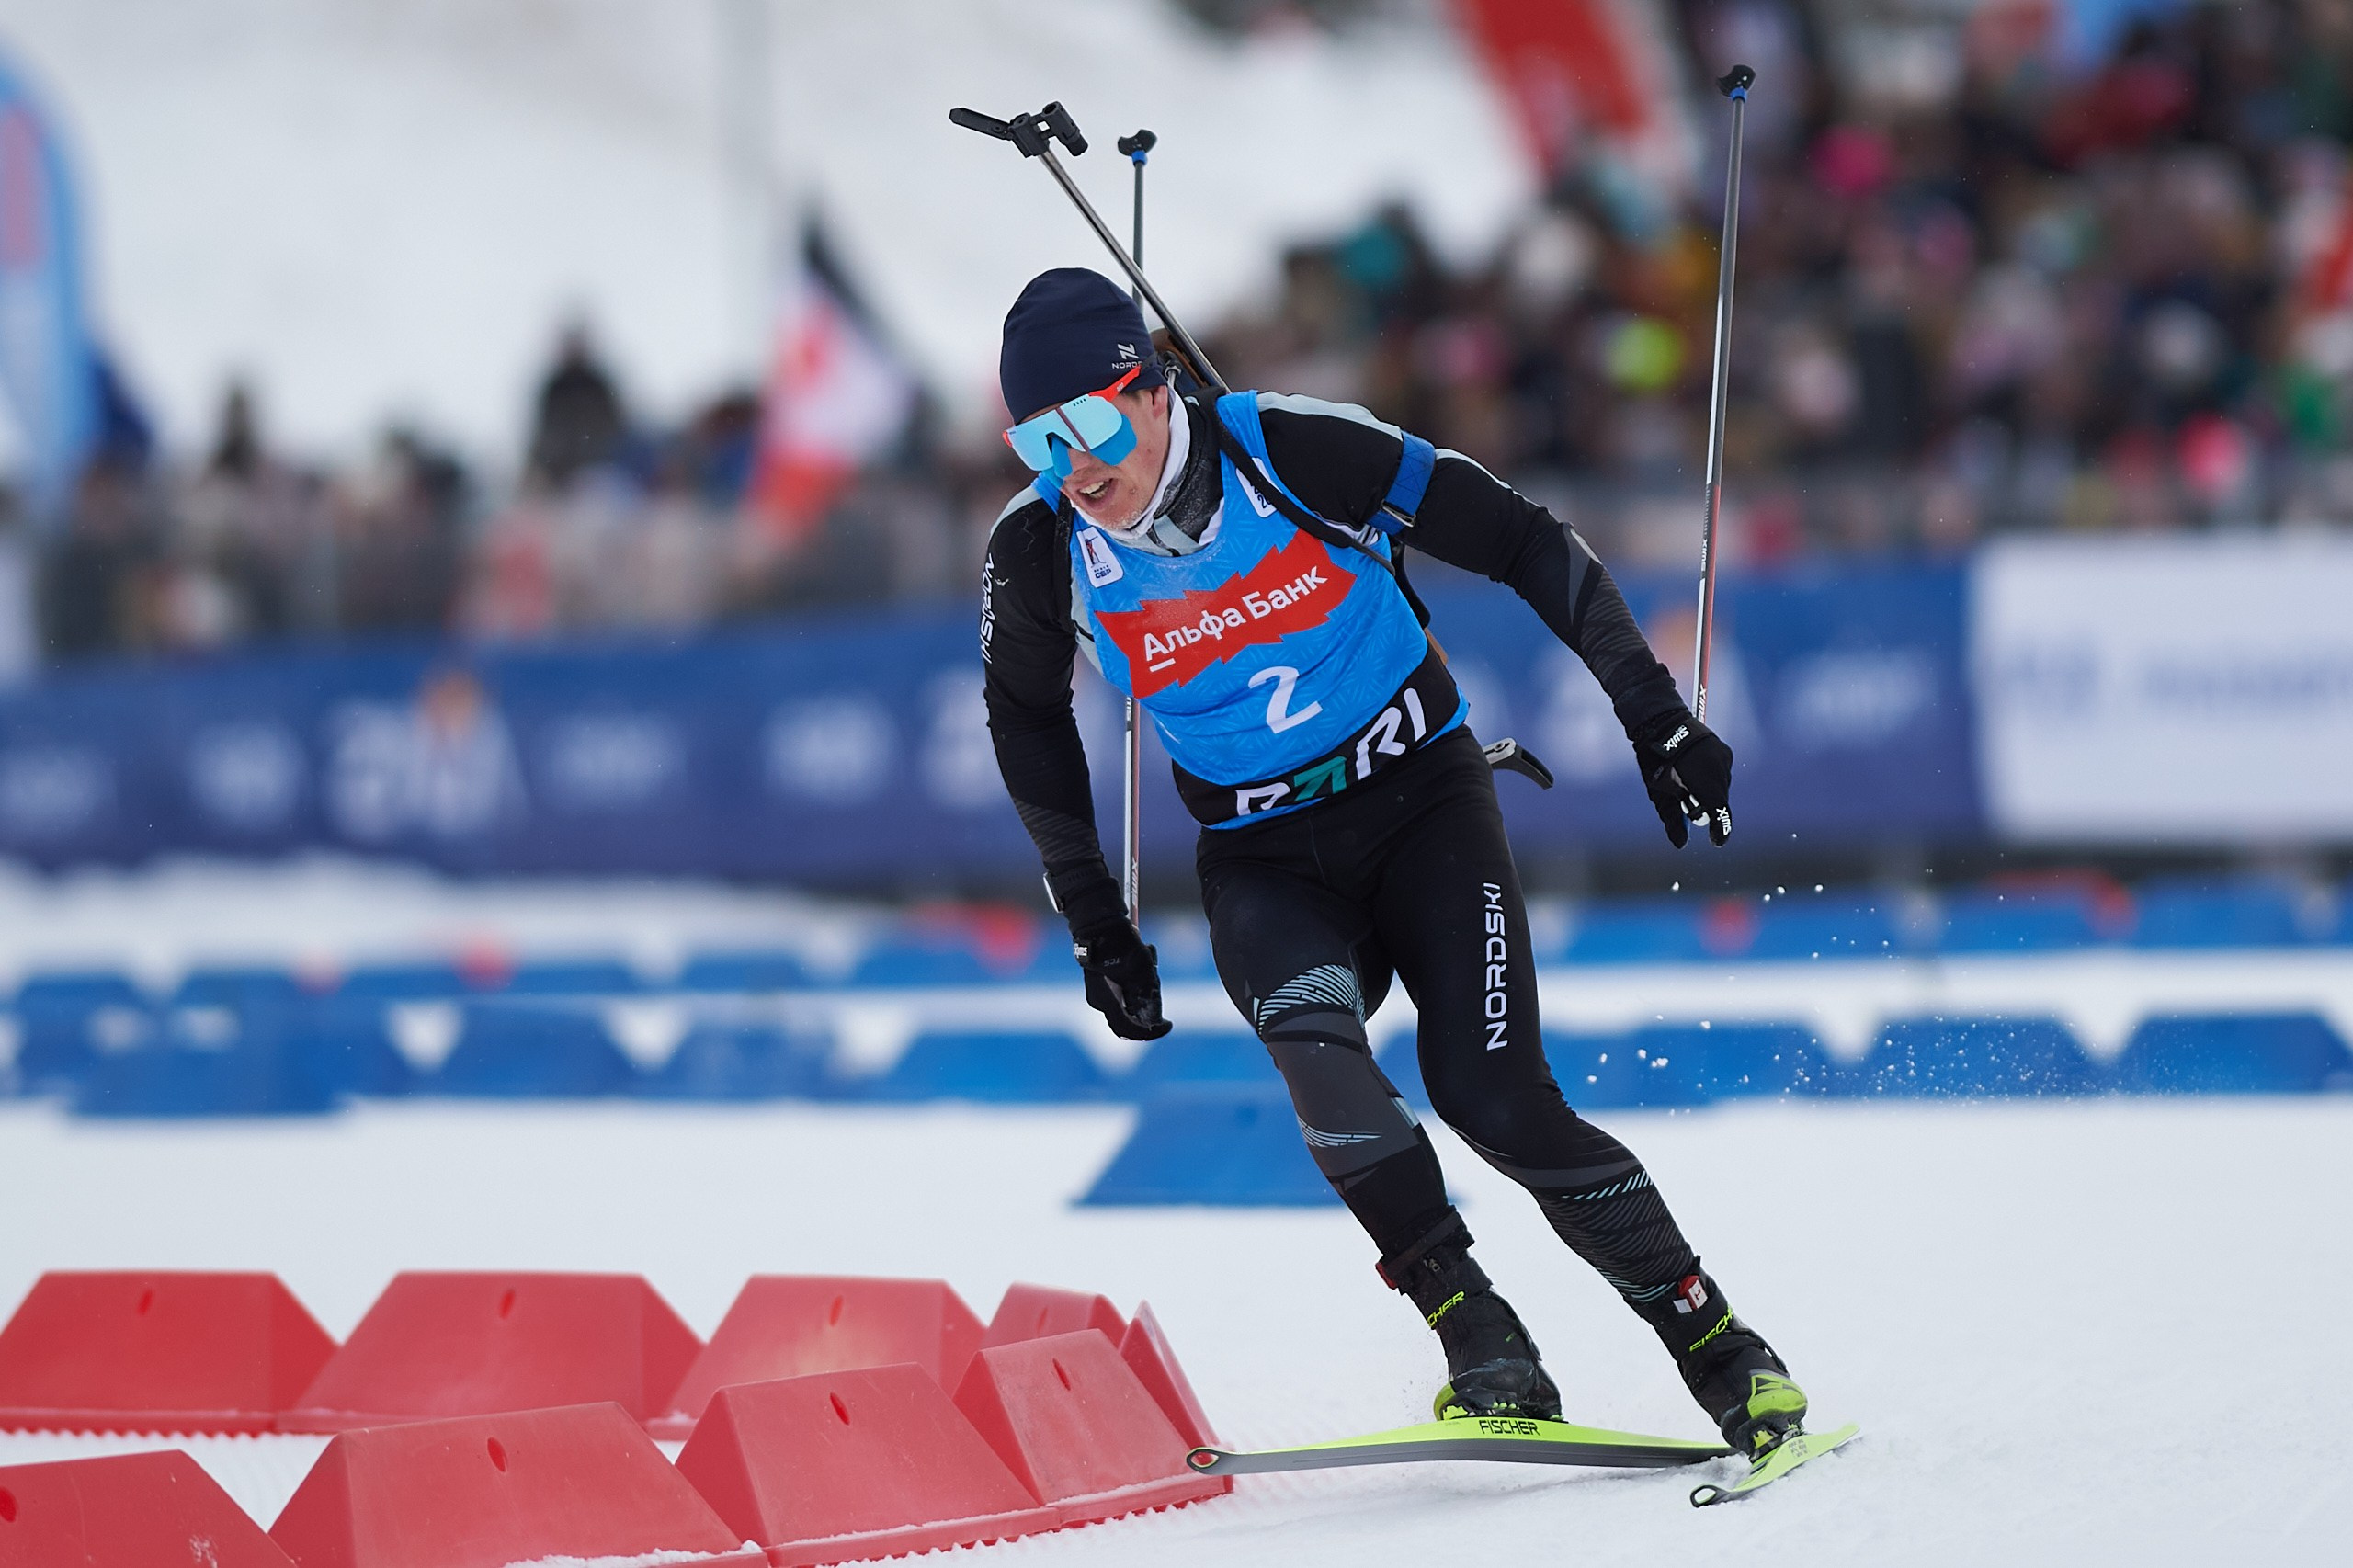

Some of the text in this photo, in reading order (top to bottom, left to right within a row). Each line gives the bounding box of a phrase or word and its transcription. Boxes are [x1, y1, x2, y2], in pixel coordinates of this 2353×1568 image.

[1143, 565, 1328, 664] Альфа Банк
[1247, 665, 1324, 734] 2
[1483, 882, 1509, 1051] NORDSKI
[1426, 1290, 1465, 1329] CHER
[1688, 1303, 1733, 1352] FISCH
[1478, 1419, 1541, 1437] FISCHER
